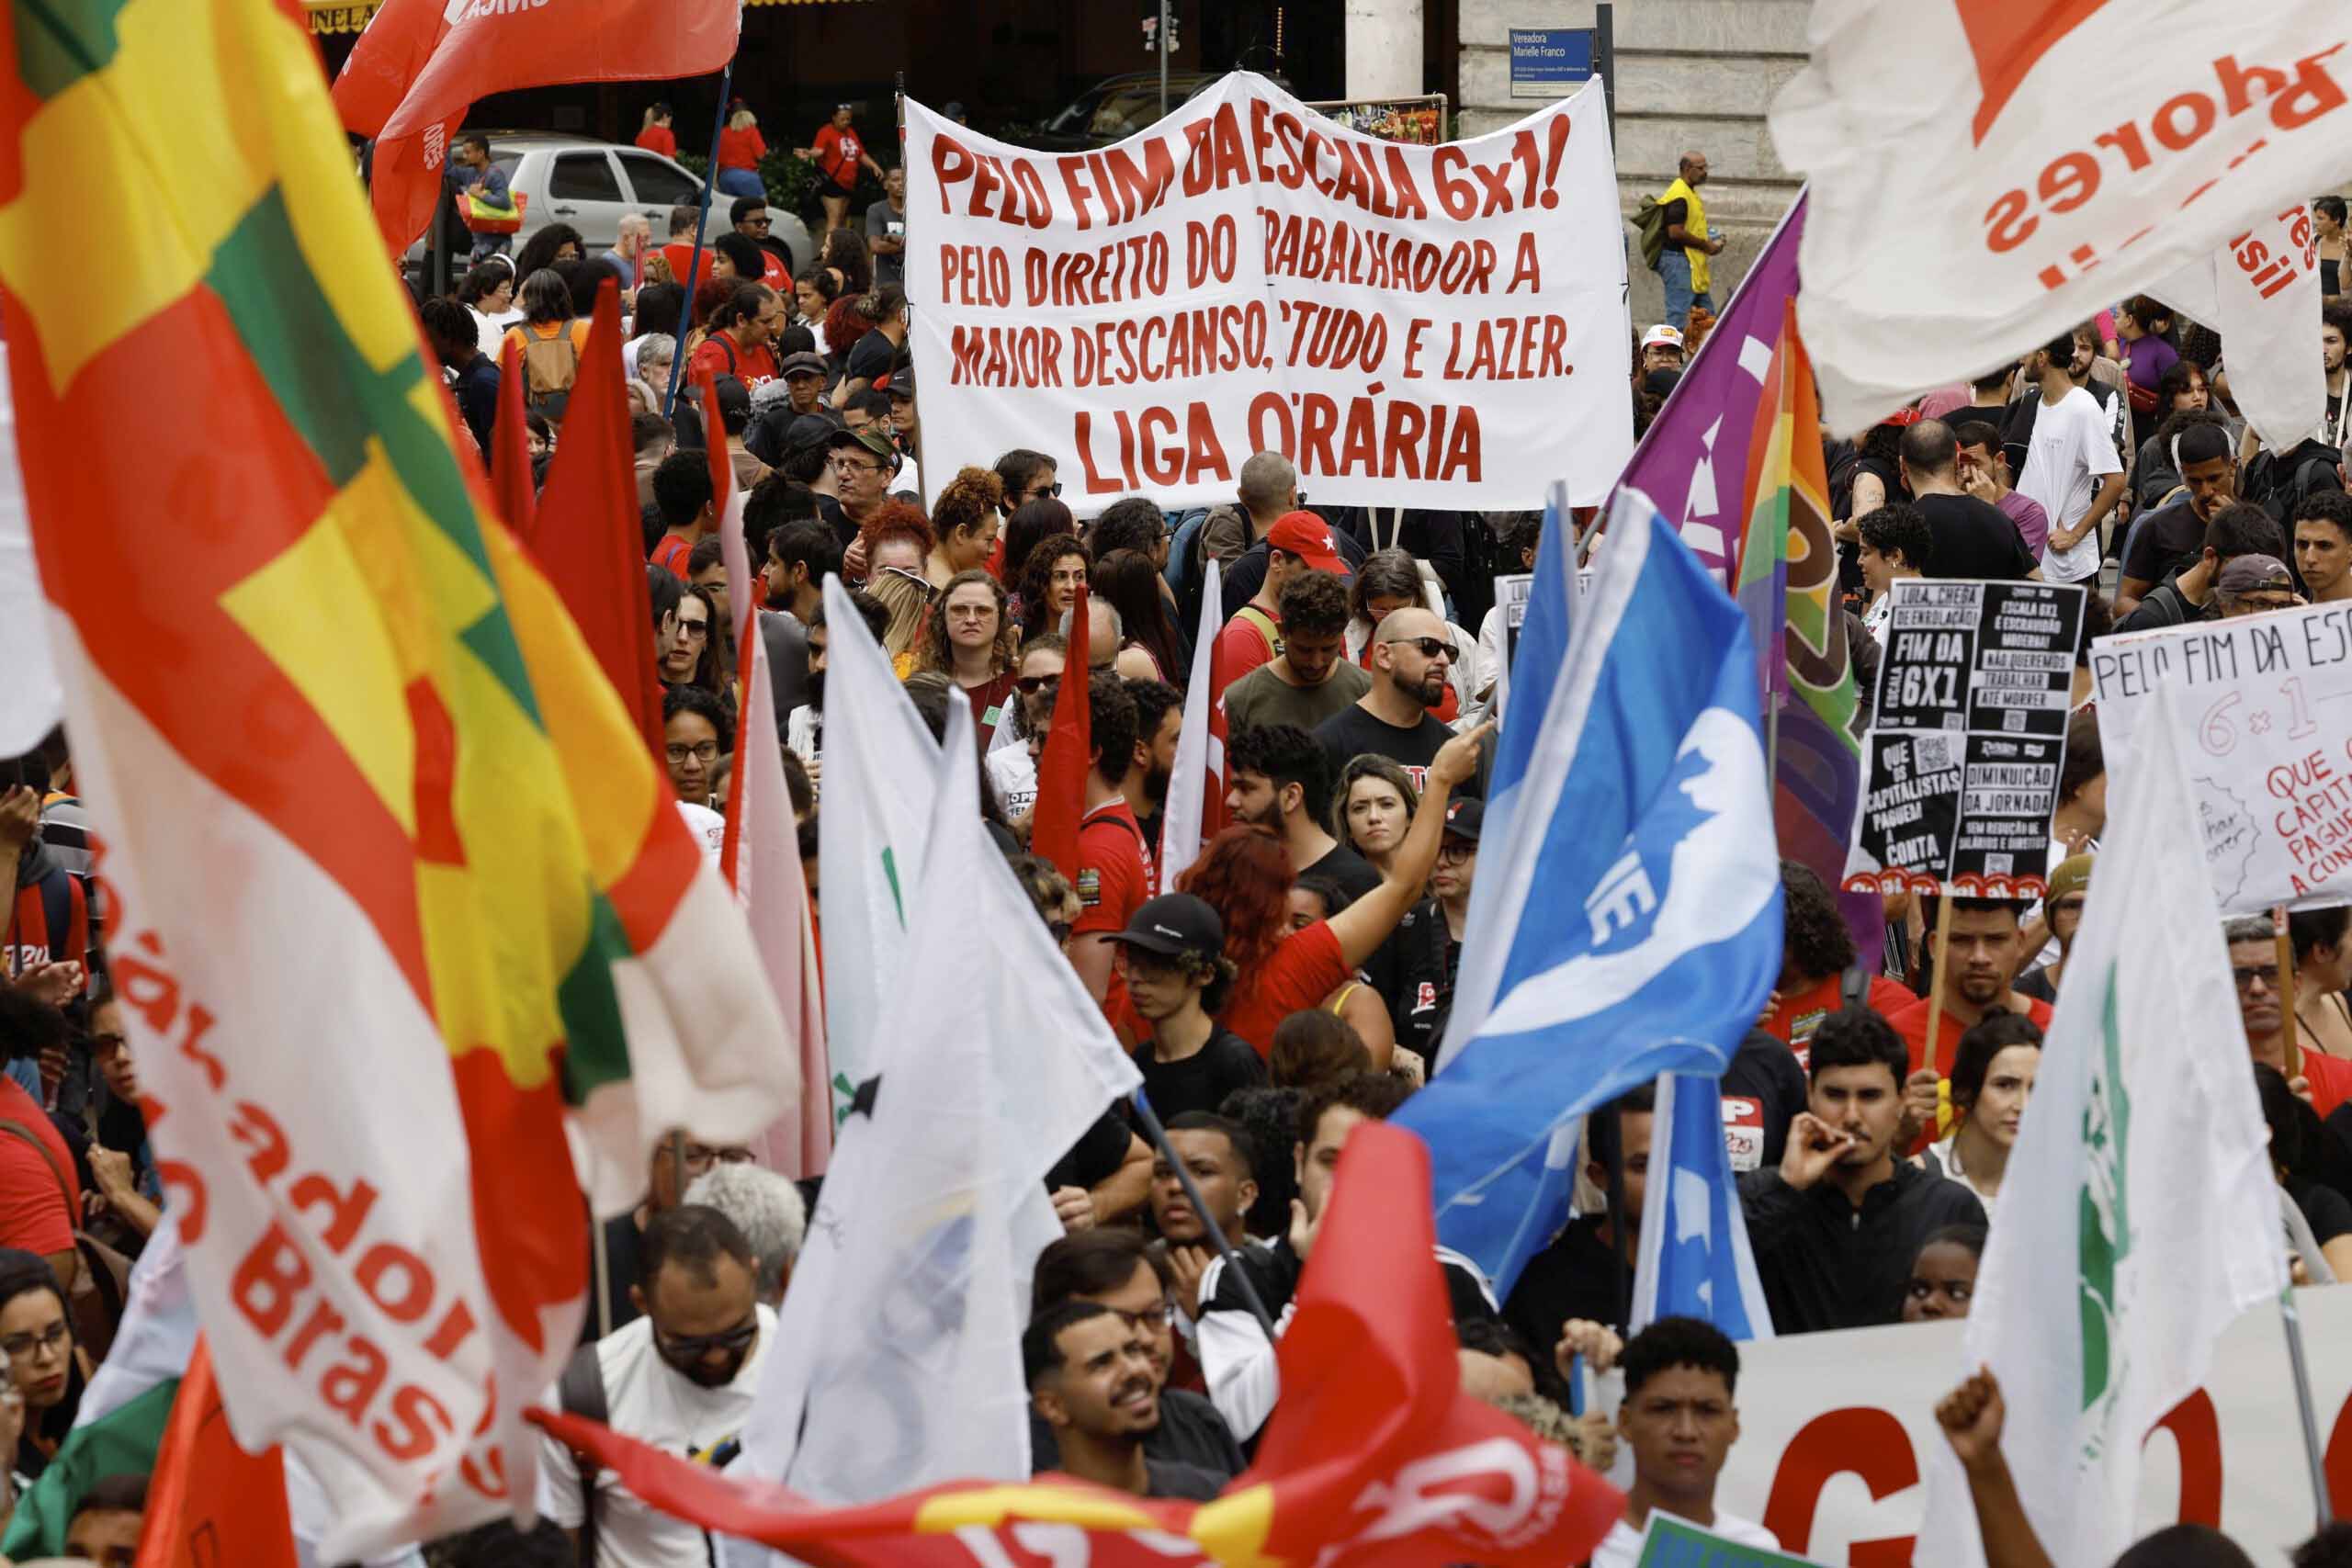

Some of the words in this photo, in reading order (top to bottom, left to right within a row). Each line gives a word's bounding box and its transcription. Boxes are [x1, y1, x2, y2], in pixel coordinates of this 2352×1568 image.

[1513, 31, 1547, 43] Vereadora
[1513, 46, 1540, 57] Marielle
[1541, 46, 1566, 57] Franco
[932, 133, 1053, 230] PELO
[1057, 137, 1175, 231] FIM
[1183, 102, 1251, 197] DA
[1250, 97, 1428, 220] ESCALA
[1431, 113, 1571, 221] 6x1!
[941, 243, 1012, 308] PELO
[1025, 231, 1170, 307] DIREITO
[1186, 213, 1237, 289] DO
[1257, 206, 1498, 295] RABALHADOR
[1506, 232, 1541, 294] A
[951, 325, 1063, 389] MAIOR
[1071, 300, 1273, 388] DESCANSO,
[1403, 318, 1433, 379] E
[1443, 314, 1575, 380] LAZER.
[1075, 401, 1233, 494] LIGA
[1894, 632, 1933, 662] FIM
[1935, 633, 1964, 663] DA
[2183, 632, 2238, 684] FIM
[2250, 625, 2290, 673] DA
[1902, 666, 1958, 707] 6X1
[1882, 740, 1910, 772] QUE
[2267, 750, 2333, 802] QUE
[1866, 770, 1962, 814] CAPITALISTAS
[1984, 793, 2052, 812] JORNADA
[1885, 833, 1940, 867] CONTA
